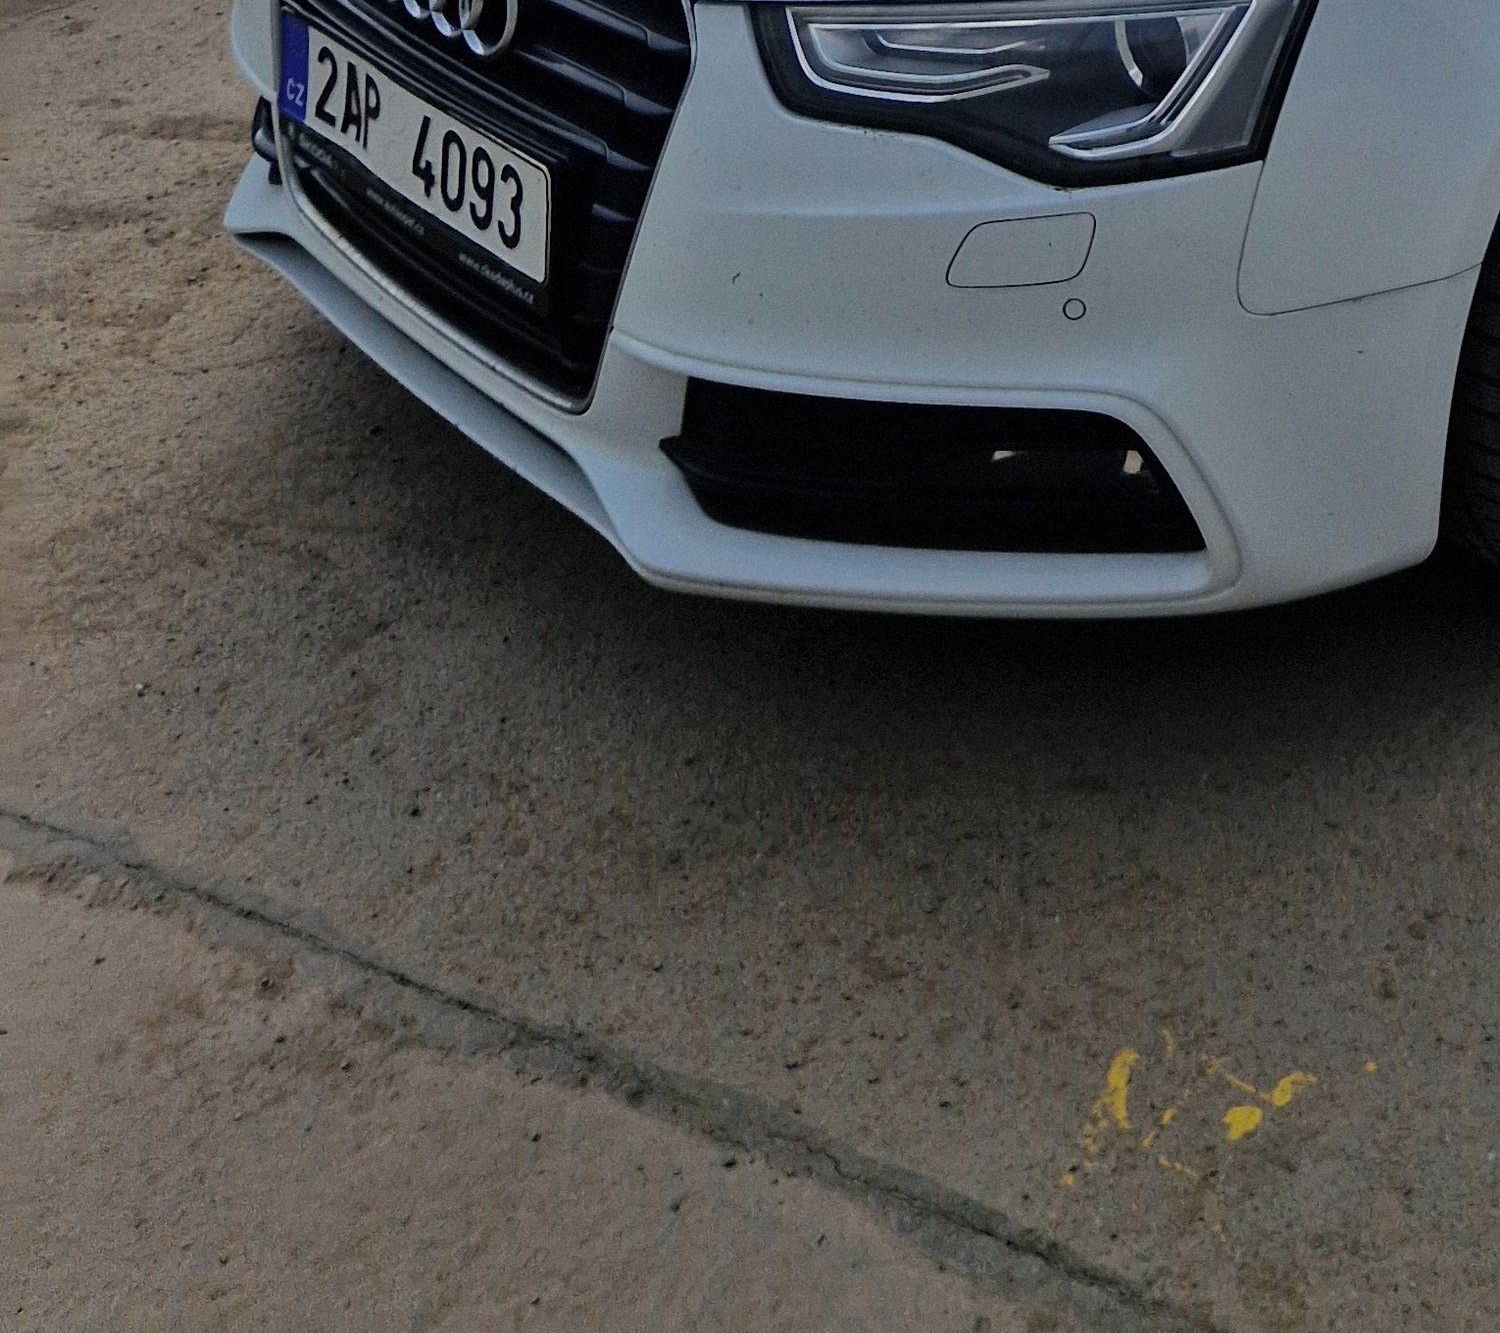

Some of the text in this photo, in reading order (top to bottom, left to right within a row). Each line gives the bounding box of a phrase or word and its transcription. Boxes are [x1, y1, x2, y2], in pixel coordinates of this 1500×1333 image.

[287, 77, 305, 107] CZ
[315, 46, 381, 150] 2AP
[412, 116, 524, 249] 4093
